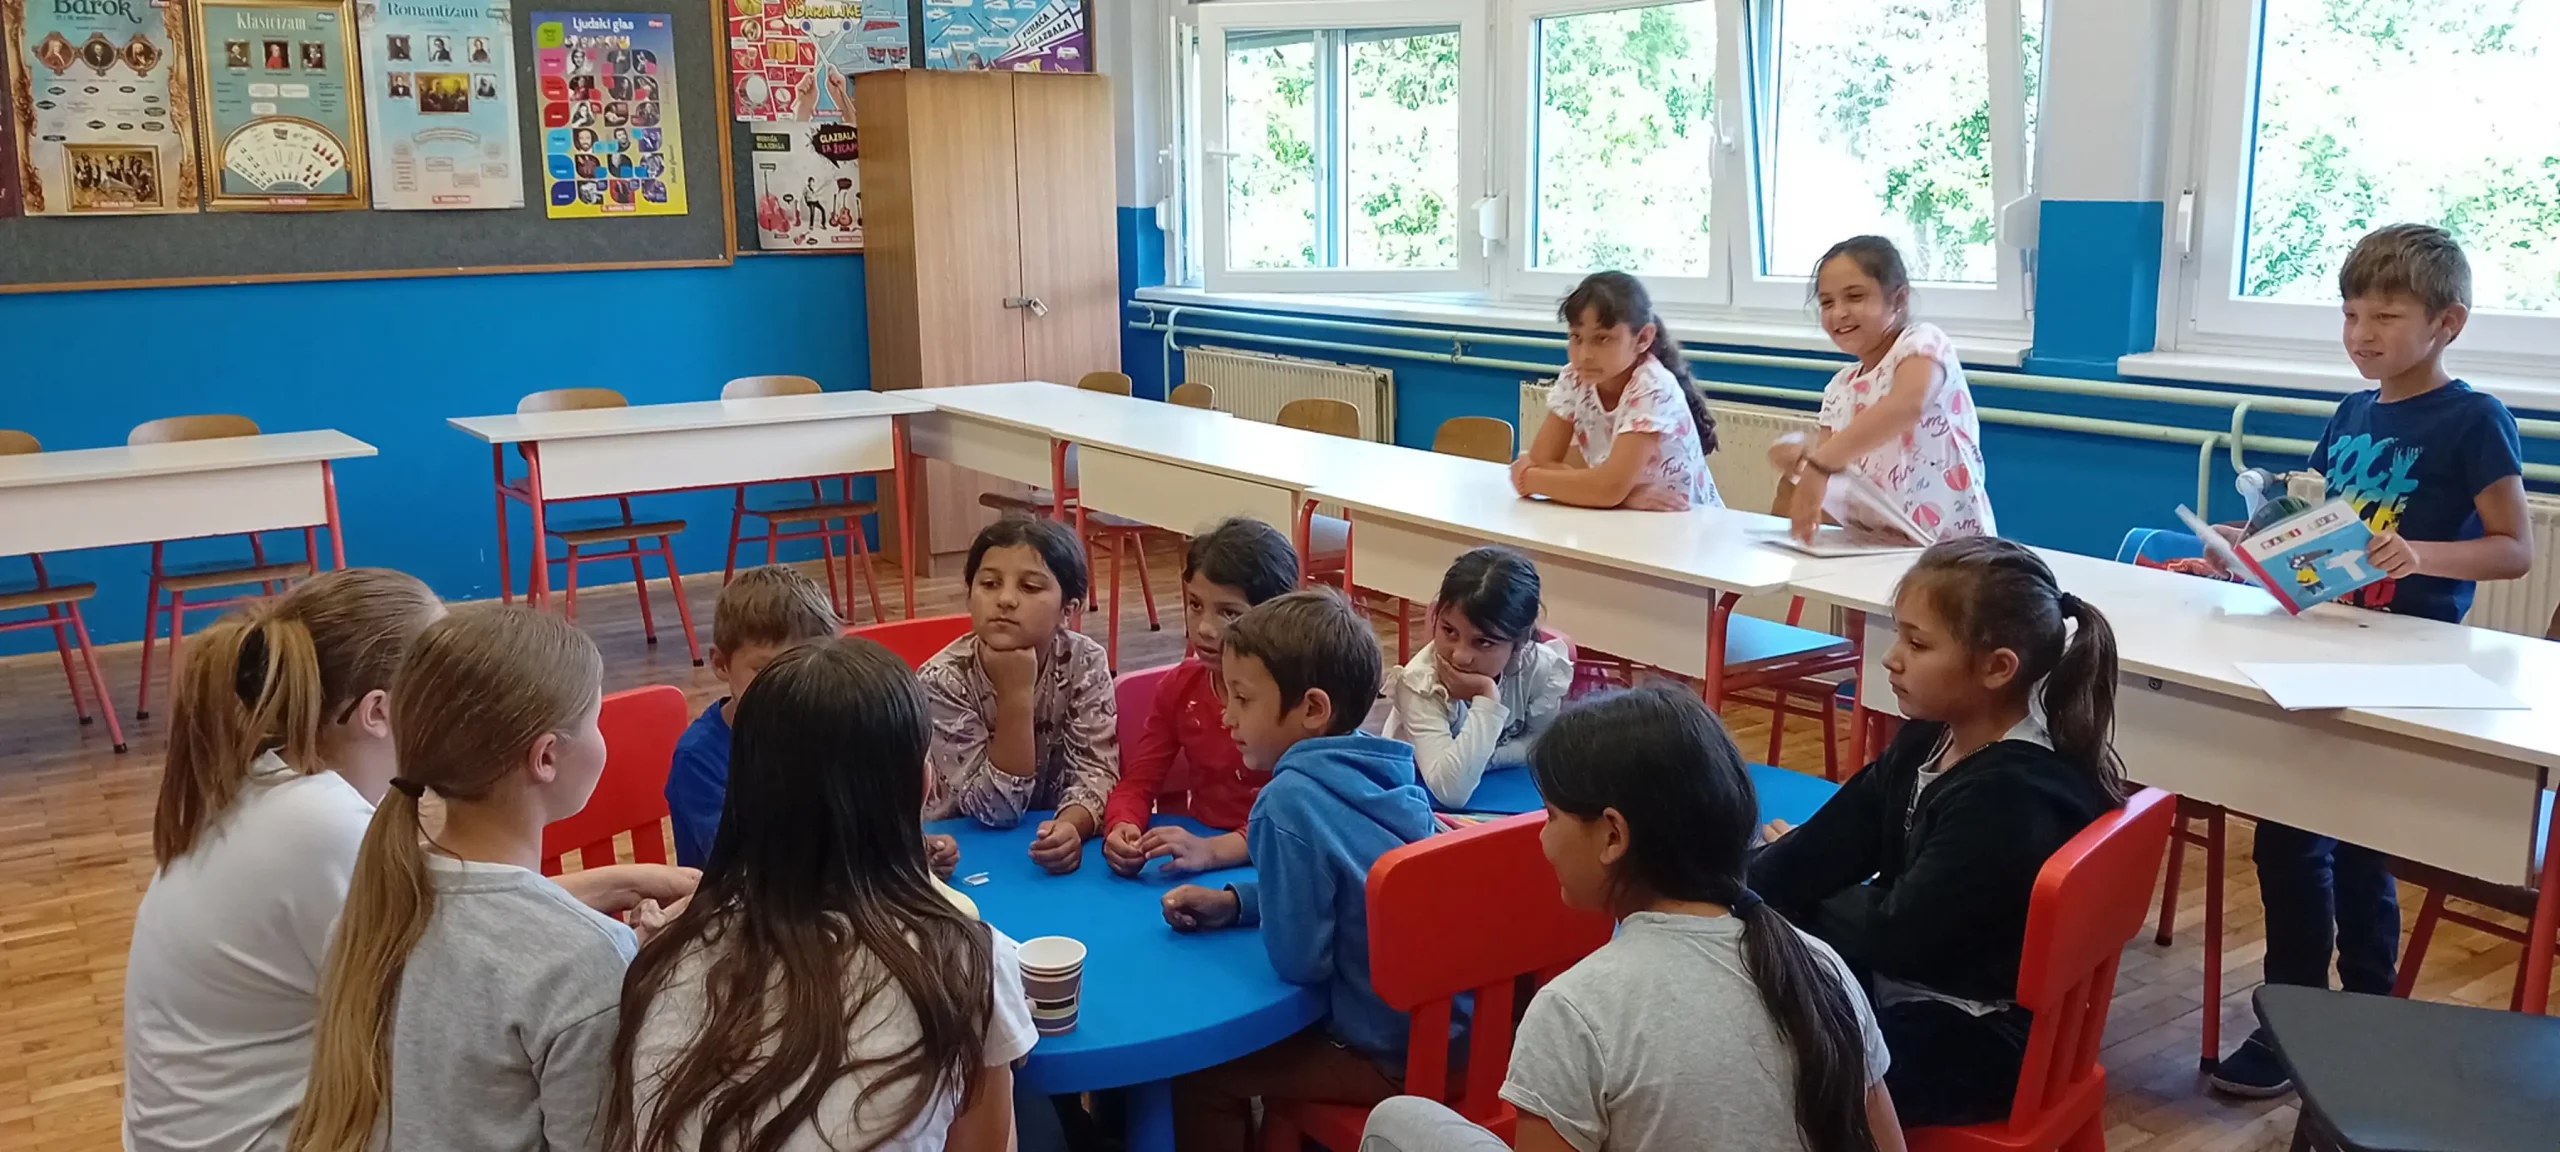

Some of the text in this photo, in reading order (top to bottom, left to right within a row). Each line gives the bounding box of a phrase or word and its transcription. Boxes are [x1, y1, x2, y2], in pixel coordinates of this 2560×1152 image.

[53, 0, 143, 24] Barok
[387, 2, 479, 18] Romantizam
[236, 11, 306, 31] Klasicizam
[572, 17, 611, 32] Ljudski
[612, 18, 635, 33] glas
[1028, 19, 1072, 47] GLAZBALA
[820, 132, 856, 144] GLAZBALA
